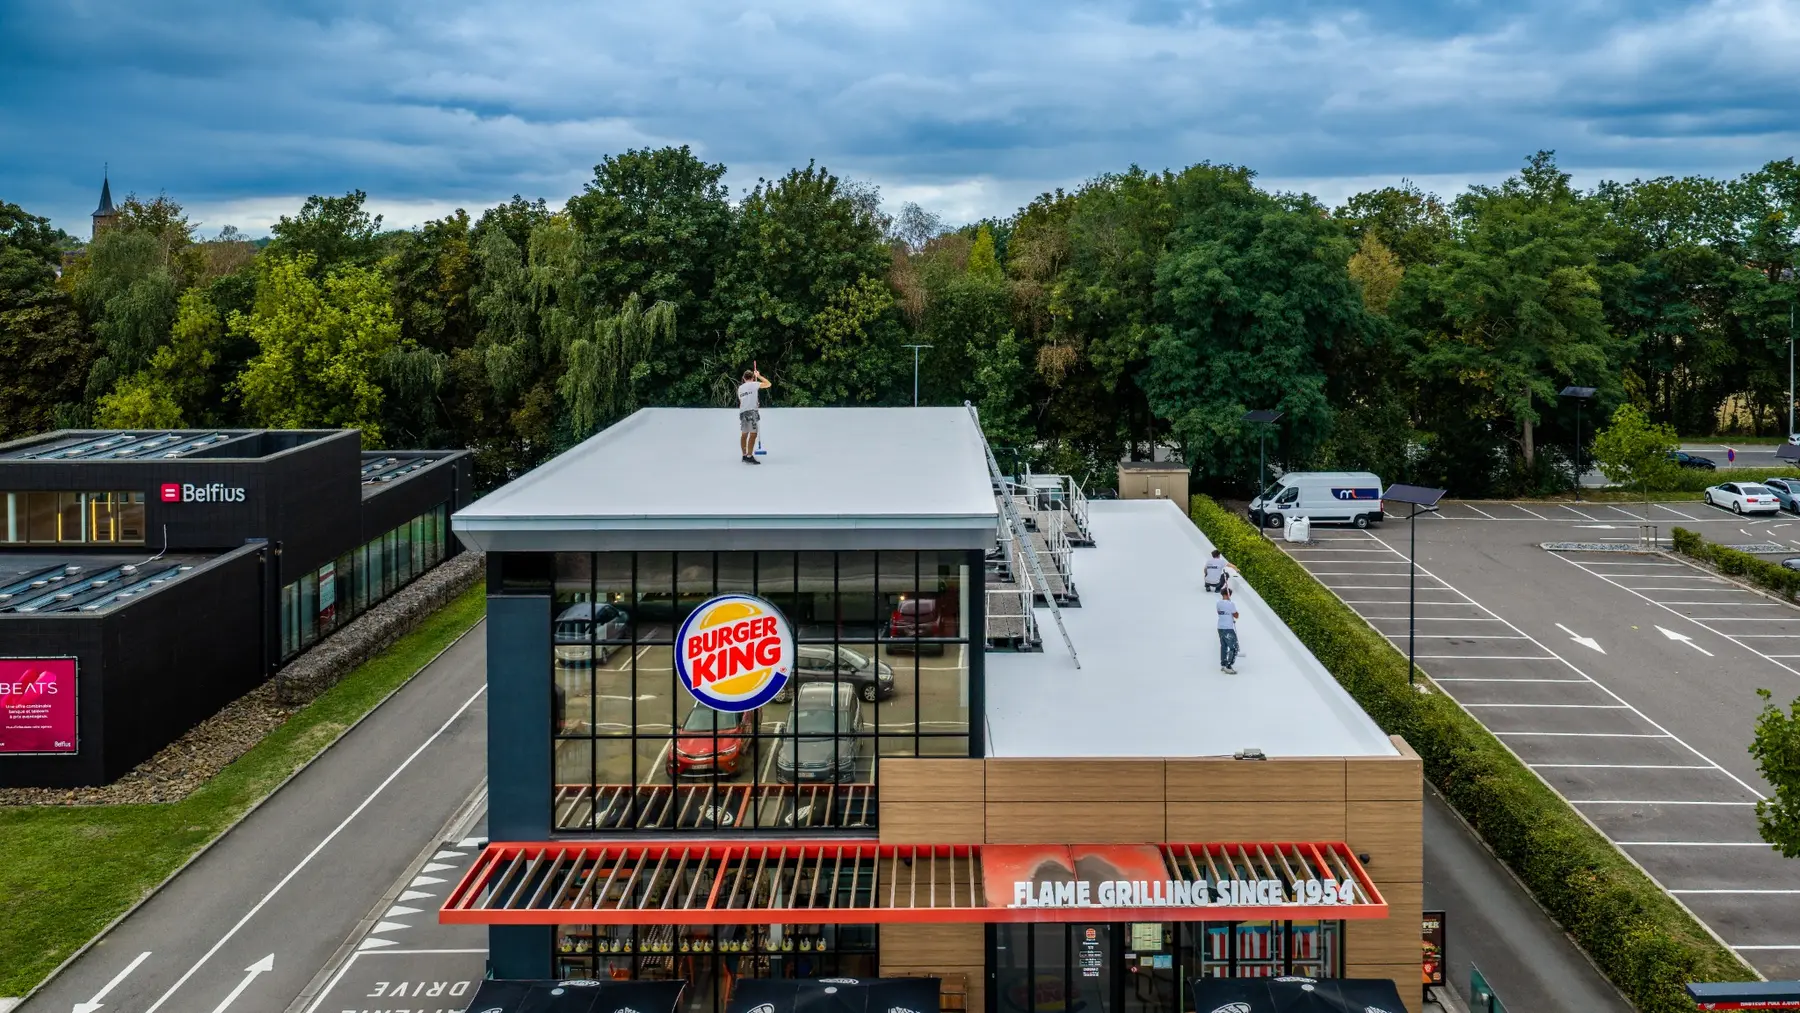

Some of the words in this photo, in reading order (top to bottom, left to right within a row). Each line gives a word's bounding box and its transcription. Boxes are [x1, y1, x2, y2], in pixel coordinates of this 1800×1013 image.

[183, 483, 246, 502] Belfius
[688, 616, 778, 660] BURGER
[692, 636, 781, 689] KING
[0, 682, 58, 695] BEATS
[1014, 881, 1091, 907] FLAME
[1098, 880, 1209, 907] GRILLING
[1216, 879, 1283, 907] SINCE
[1292, 879, 1355, 906] 1954
[366, 981, 471, 997] DRIVE
